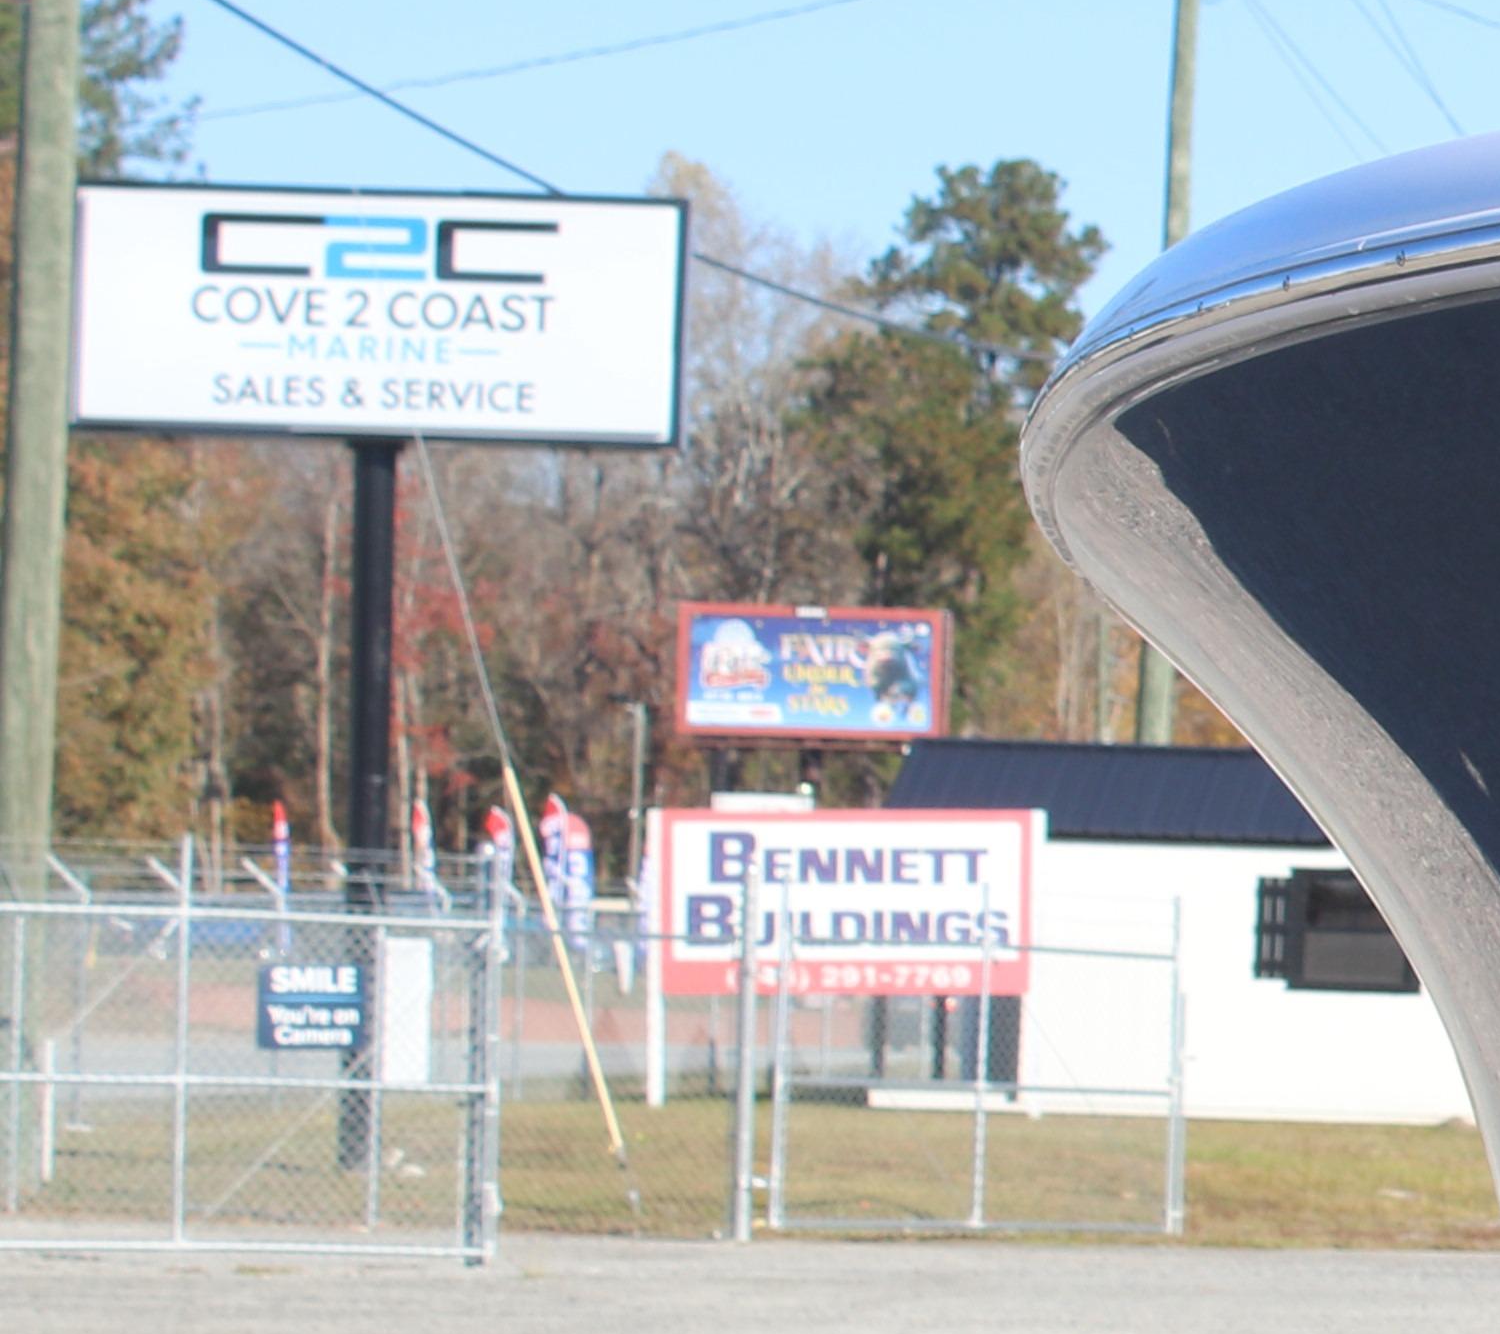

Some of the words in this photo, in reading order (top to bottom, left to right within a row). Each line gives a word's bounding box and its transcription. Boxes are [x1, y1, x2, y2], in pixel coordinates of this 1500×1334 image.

[201, 212, 559, 284] C2C
[191, 285, 327, 326] COVE
[345, 290, 369, 328] 2
[388, 291, 554, 333] COAST
[287, 334, 452, 365] MARINE
[213, 373, 326, 407] SALES
[340, 376, 364, 408] &
[381, 378, 536, 414] SERVICE
[709, 831, 988, 884] BENNETT
[270, 966, 358, 994] SMILE
[266, 1004, 331, 1026] You're
[332, 1008, 360, 1026] on
[274, 1025, 353, 1046] Camera
